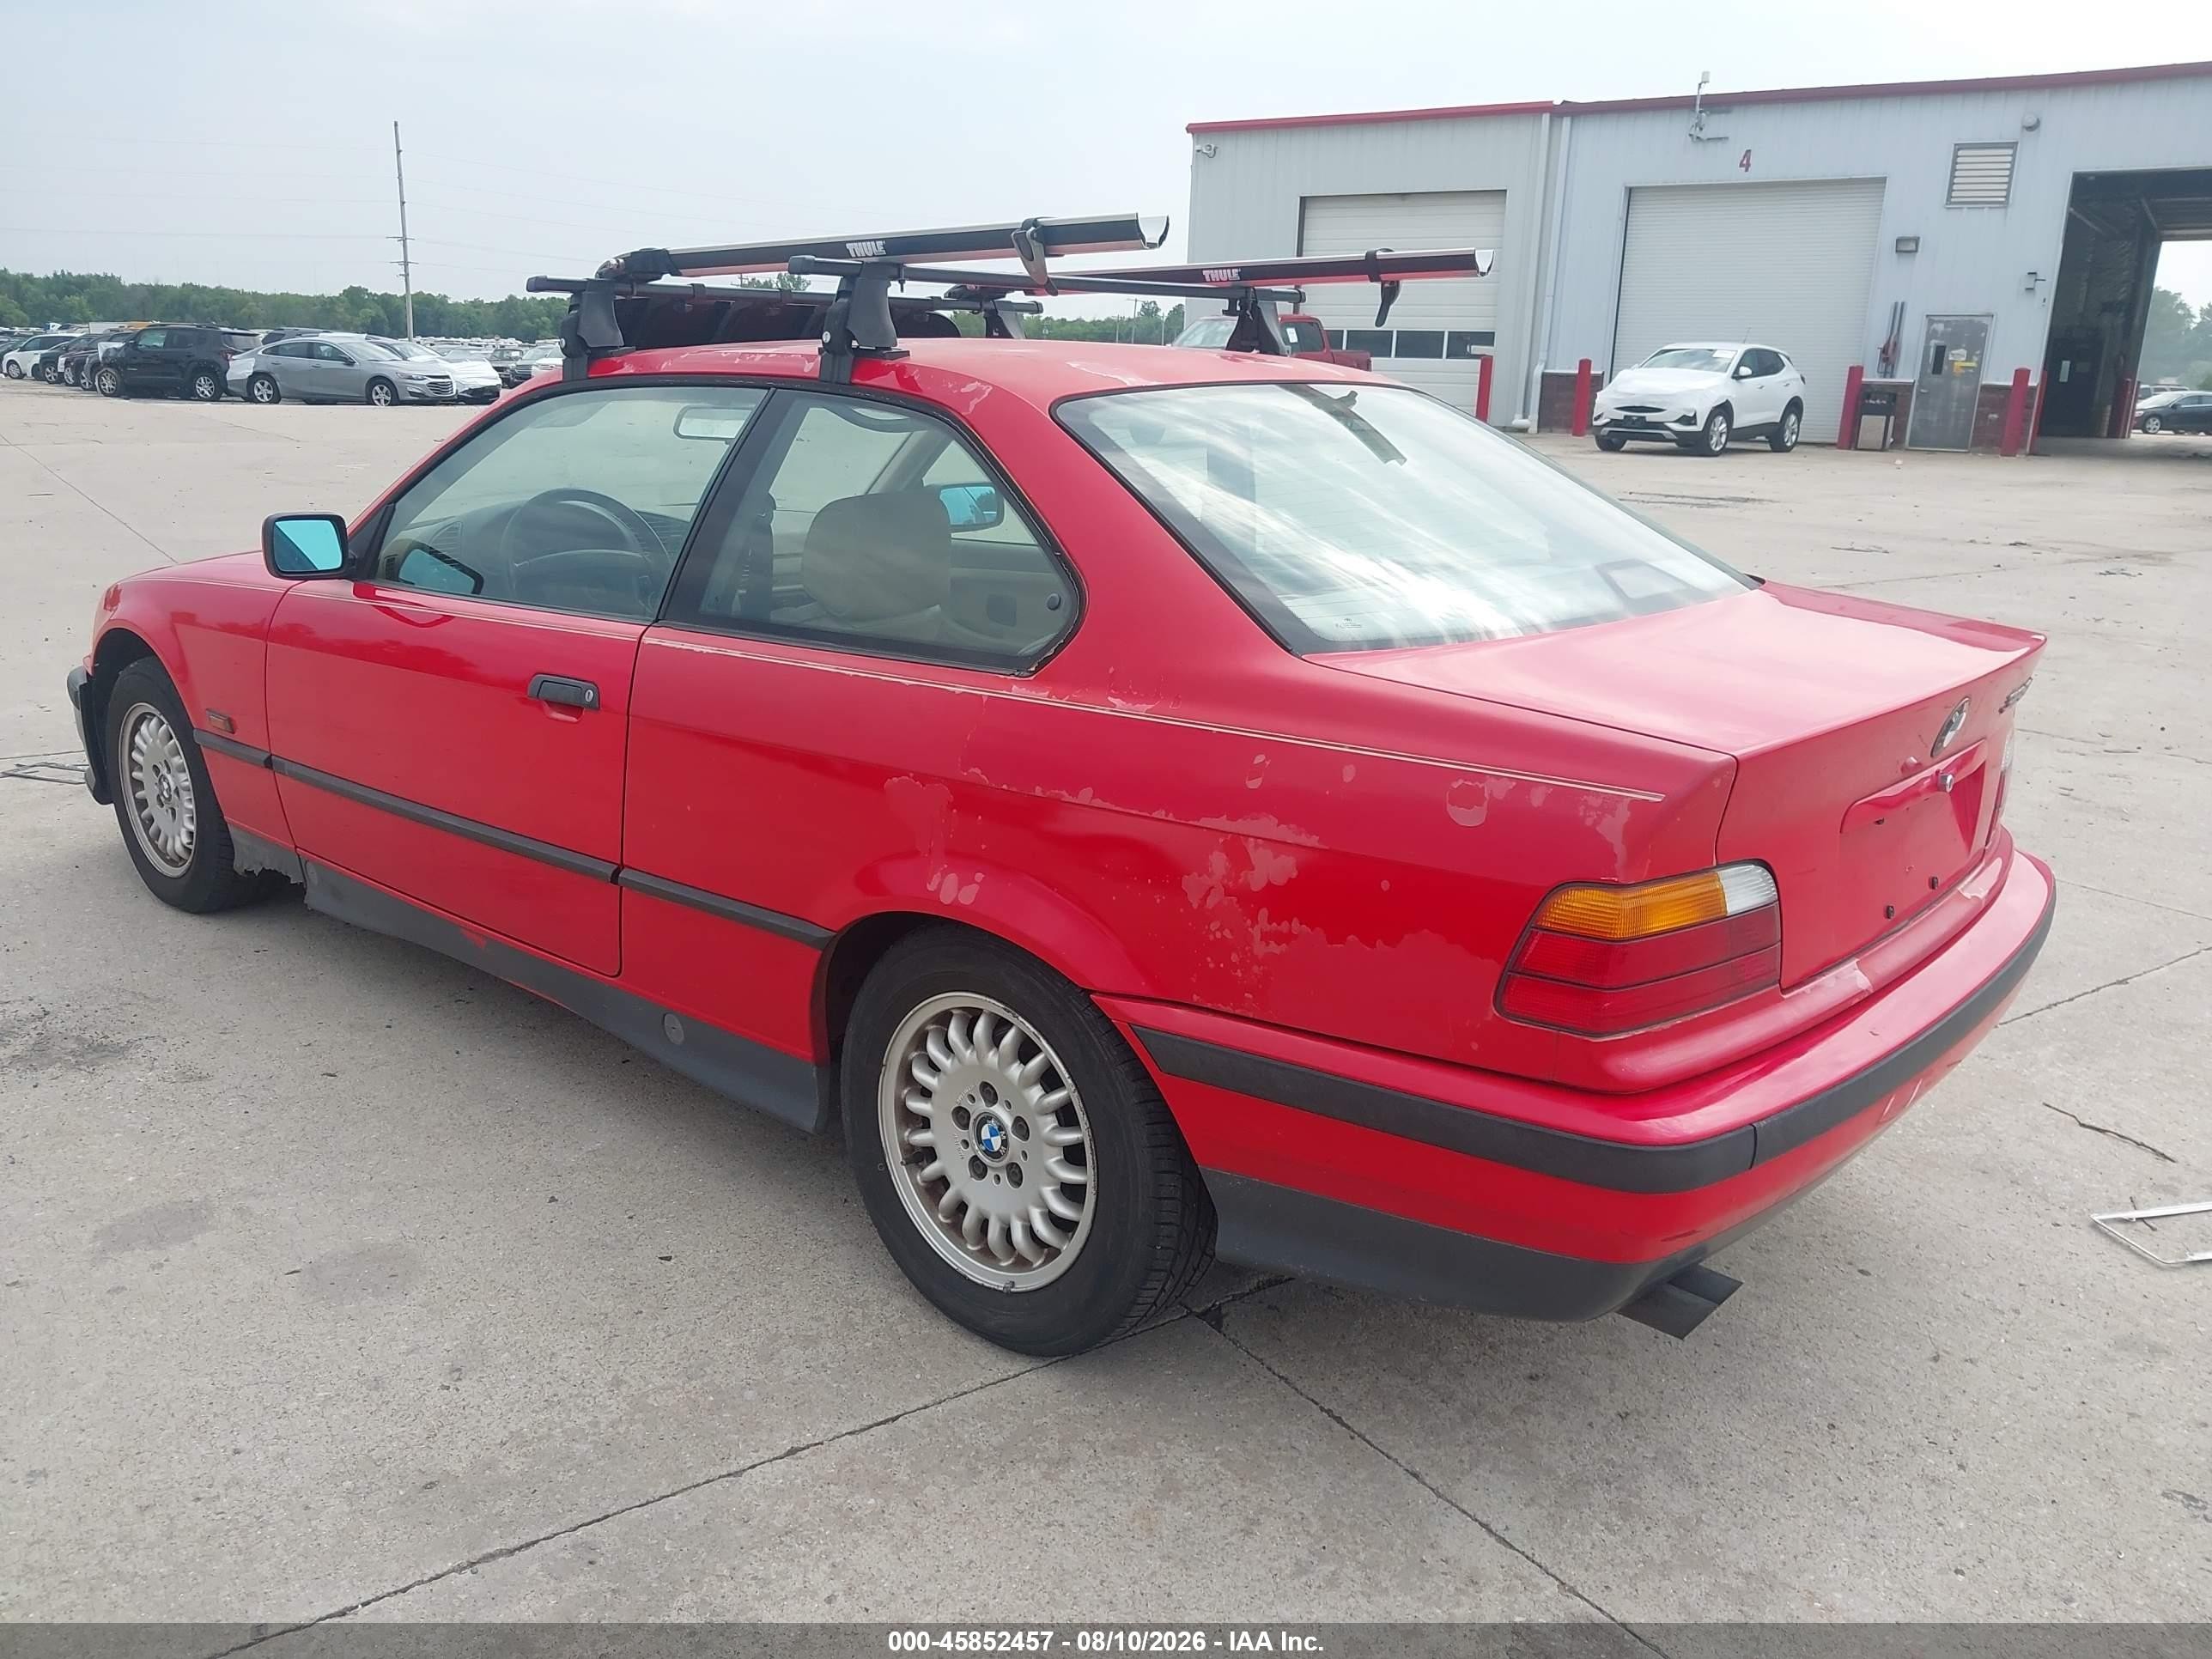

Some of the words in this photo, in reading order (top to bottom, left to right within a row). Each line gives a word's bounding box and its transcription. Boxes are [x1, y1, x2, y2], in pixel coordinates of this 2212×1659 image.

[1739, 149, 1752, 173] 4
[846, 240, 887, 258] THULE
[1202, 268, 1241, 283] THULE
